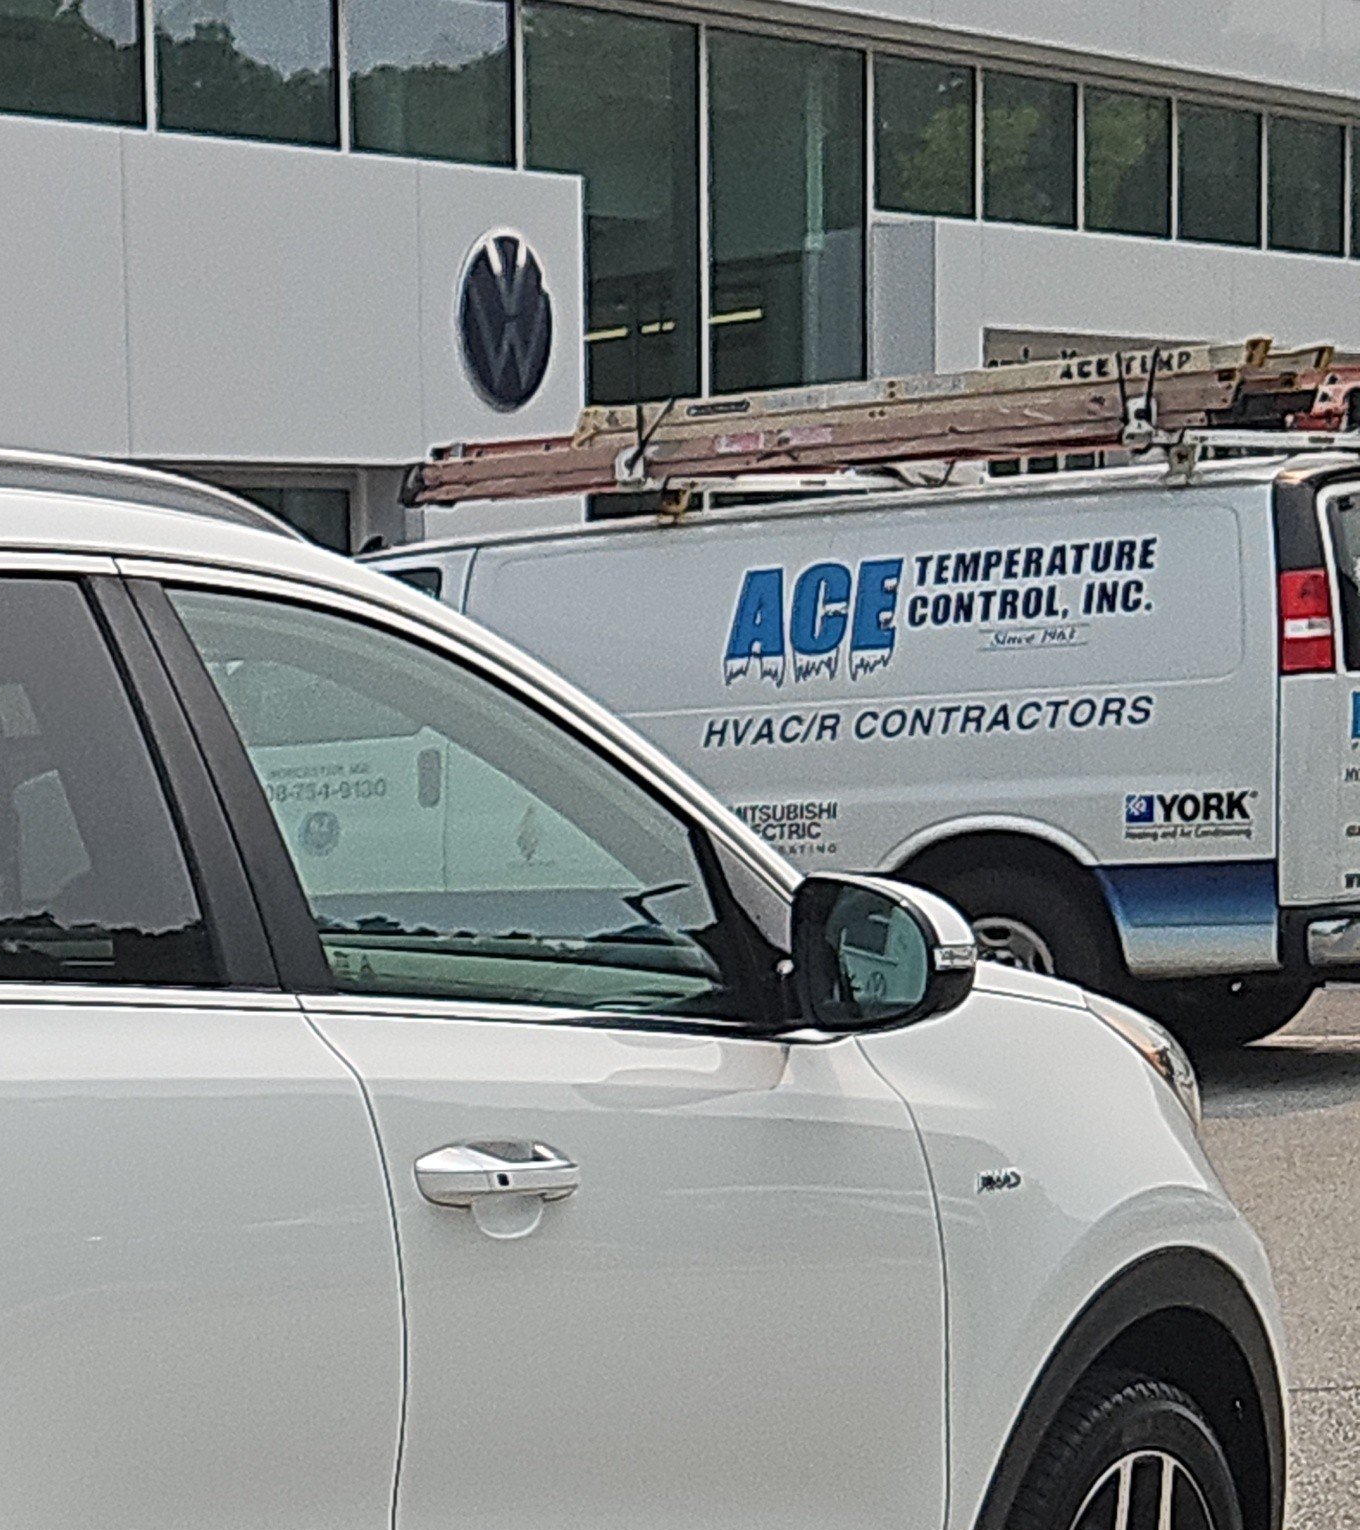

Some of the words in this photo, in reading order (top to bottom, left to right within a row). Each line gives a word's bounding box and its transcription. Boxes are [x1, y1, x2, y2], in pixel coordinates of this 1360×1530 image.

[915, 537, 1157, 586] TEMPERATURE
[725, 557, 904, 668] ACE
[908, 585, 1069, 627] CONTROL,
[1083, 580, 1153, 615] INC.
[703, 713, 841, 747] HVAC/R
[854, 696, 1153, 740] CONTRACTORS
[1157, 791, 1250, 822] YORK
